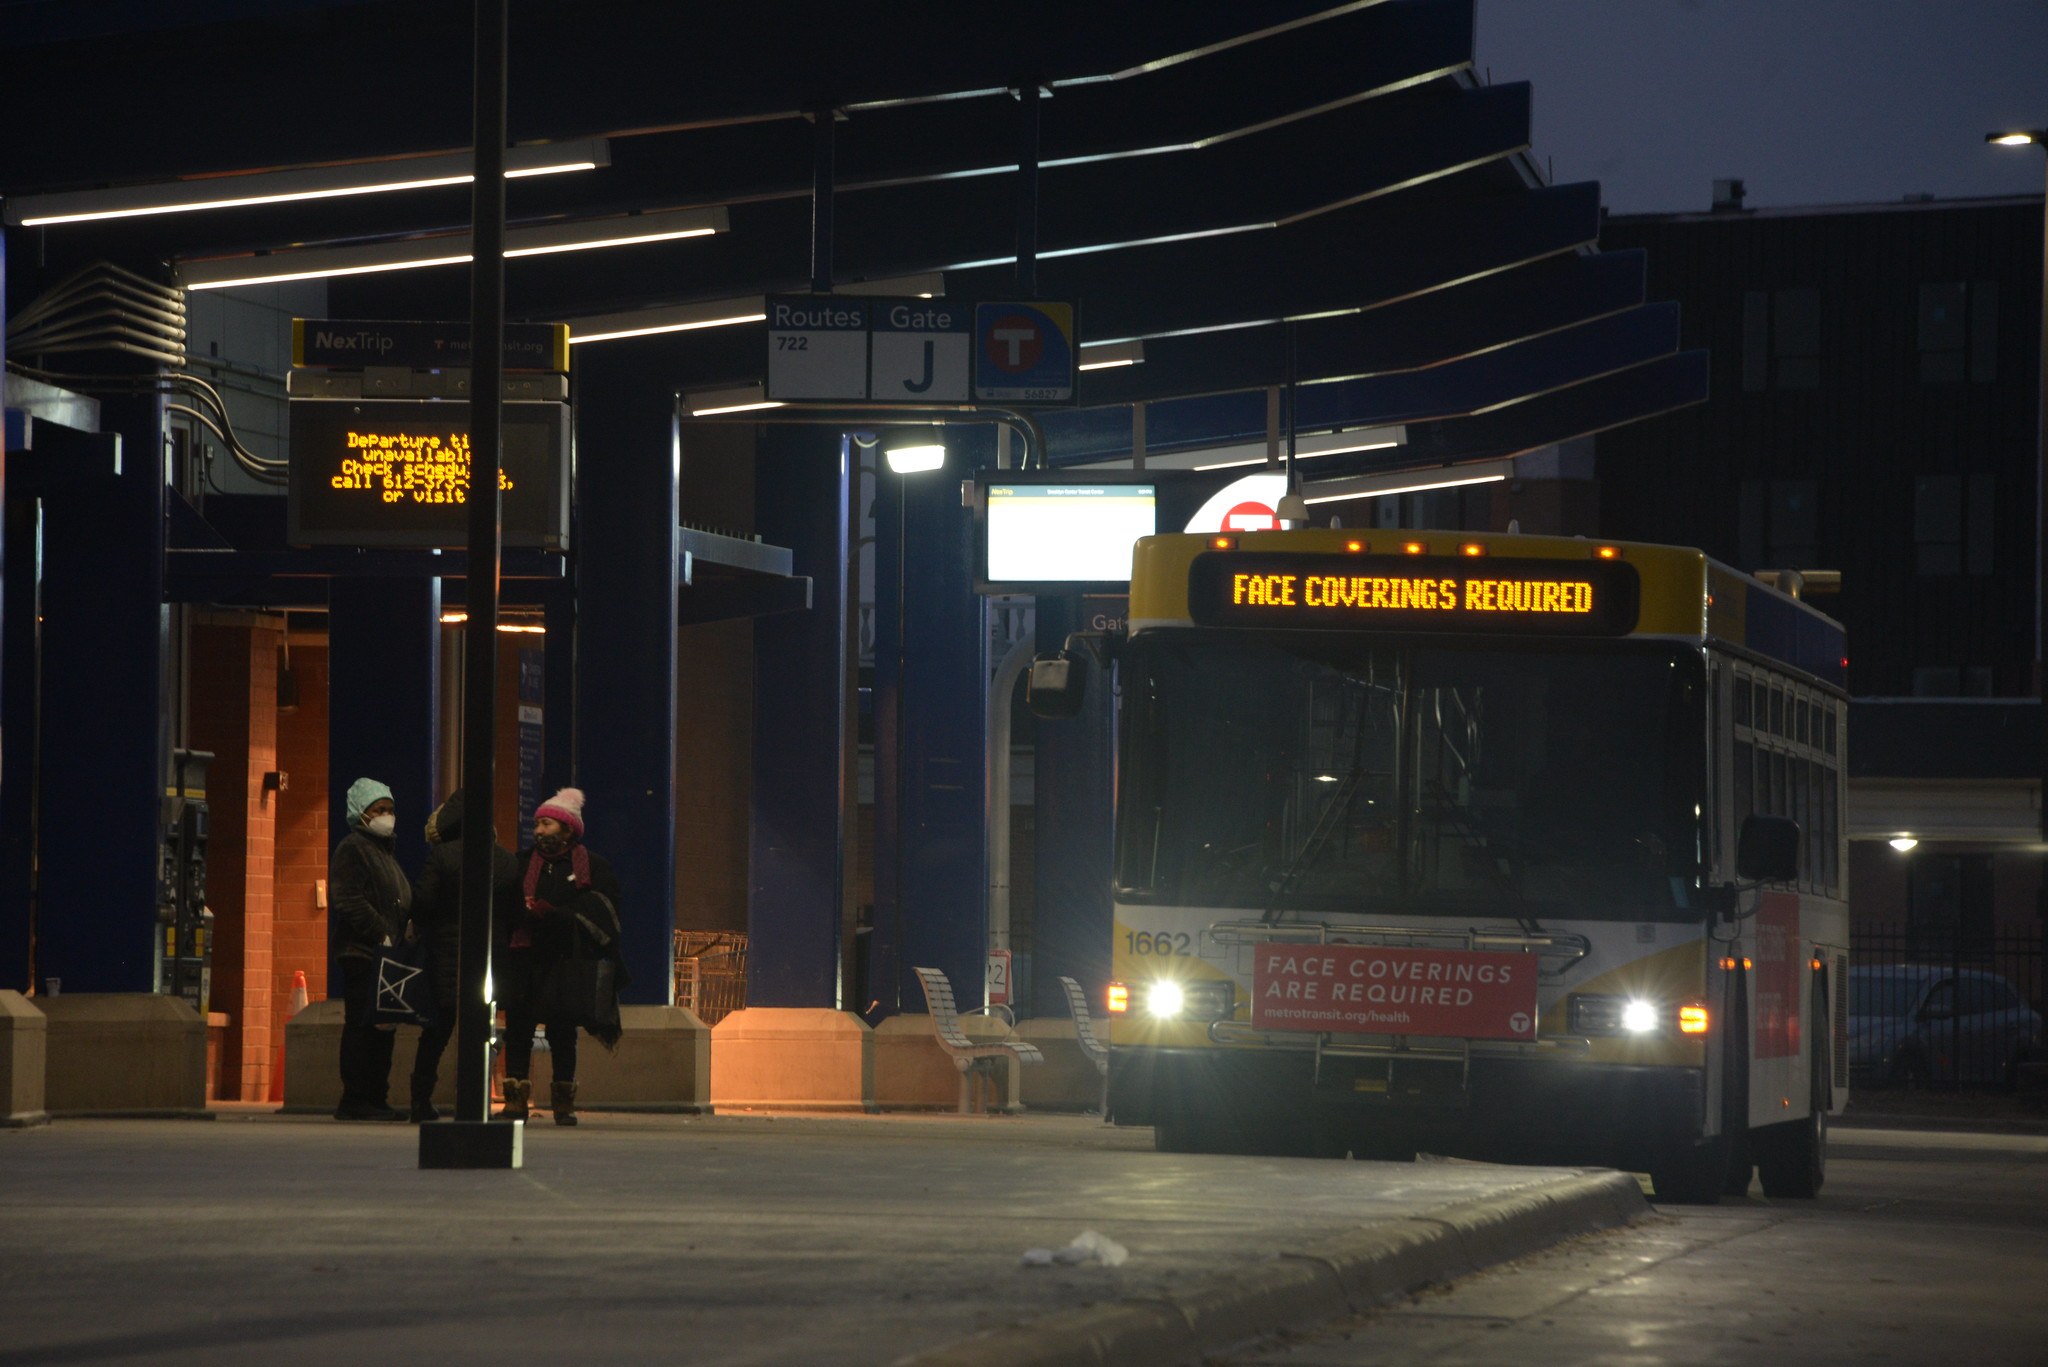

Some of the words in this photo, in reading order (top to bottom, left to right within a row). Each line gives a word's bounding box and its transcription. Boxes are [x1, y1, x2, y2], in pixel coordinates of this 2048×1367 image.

[775, 304, 861, 327] Routes
[890, 305, 951, 329] Gate
[315, 331, 394, 355] NexTrip
[777, 336, 808, 351] 722
[993, 328, 1035, 366] T
[903, 340, 934, 393] J
[341, 459, 393, 476] Check
[331, 474, 372, 489] call
[382, 489, 404, 503] or
[413, 488, 466, 504] visit
[1233, 574, 1297, 606] FACE
[1304, 576, 1457, 610] COVERINGS
[1464, 579, 1593, 613] REQUIRED
[1092, 614, 1123, 630] Gat
[1126, 931, 1191, 956] 1662
[1267, 956, 1336, 977] FACE
[1349, 959, 1512, 984] COVERINGS
[1265, 980, 1318, 1000] ARE
[1331, 983, 1475, 1006] REQUIRED
[1264, 1008, 1411, 1025] metrotransit.org/health
